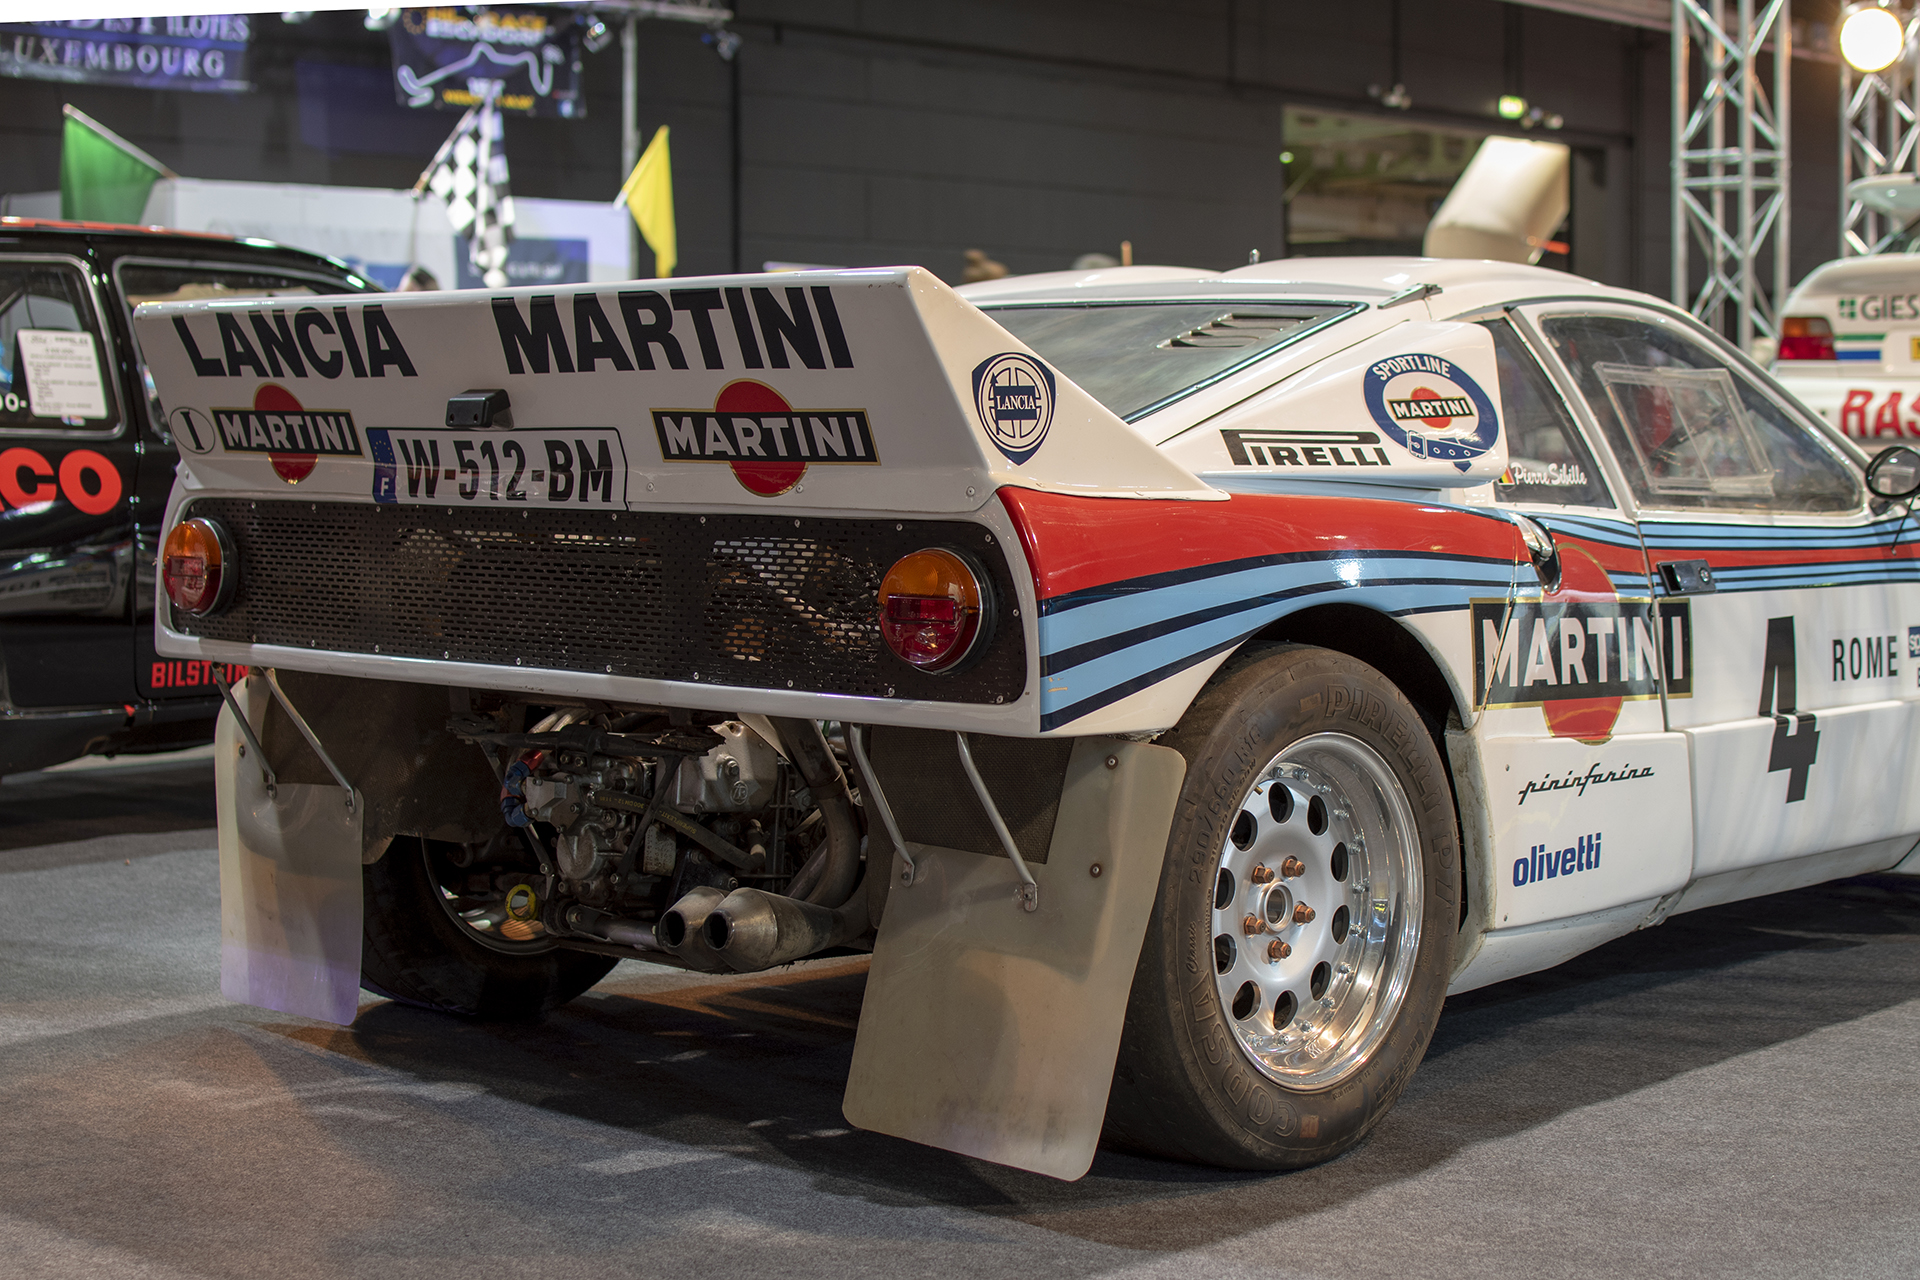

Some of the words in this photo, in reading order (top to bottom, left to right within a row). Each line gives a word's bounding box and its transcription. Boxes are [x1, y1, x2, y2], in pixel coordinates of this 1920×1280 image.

[0, 35, 226, 79] UXEMBOURG
[171, 304, 418, 379] LANCIA
[491, 285, 855, 376] MARTINI
[1371, 353, 1451, 381] SPORTLINE
[996, 395, 1036, 412] LANCIA
[1393, 398, 1472, 420] MARTINI
[218, 410, 360, 454] MARTINI
[661, 416, 867, 457] MARTINI
[1219, 429, 1391, 467] PIRELLI
[0, 447, 122, 515] CO
[380, 477, 391, 497] F
[396, 438, 613, 503] W-512-BM
[1510, 461, 1550, 485] Pierre
[1547, 462, 1588, 485] Sibille
[1482, 615, 1684, 690] MARTINI
[1832, 635, 1899, 682] ROME
[1757, 615, 1821, 804] 4
[1324, 684, 1444, 815] PIRELLI
[1517, 762, 1655, 806] pininfarina
[1512, 833, 1602, 887] olivetti
[1185, 920, 1198, 975] Classic
[1189, 971, 1299, 1138] CORSA
